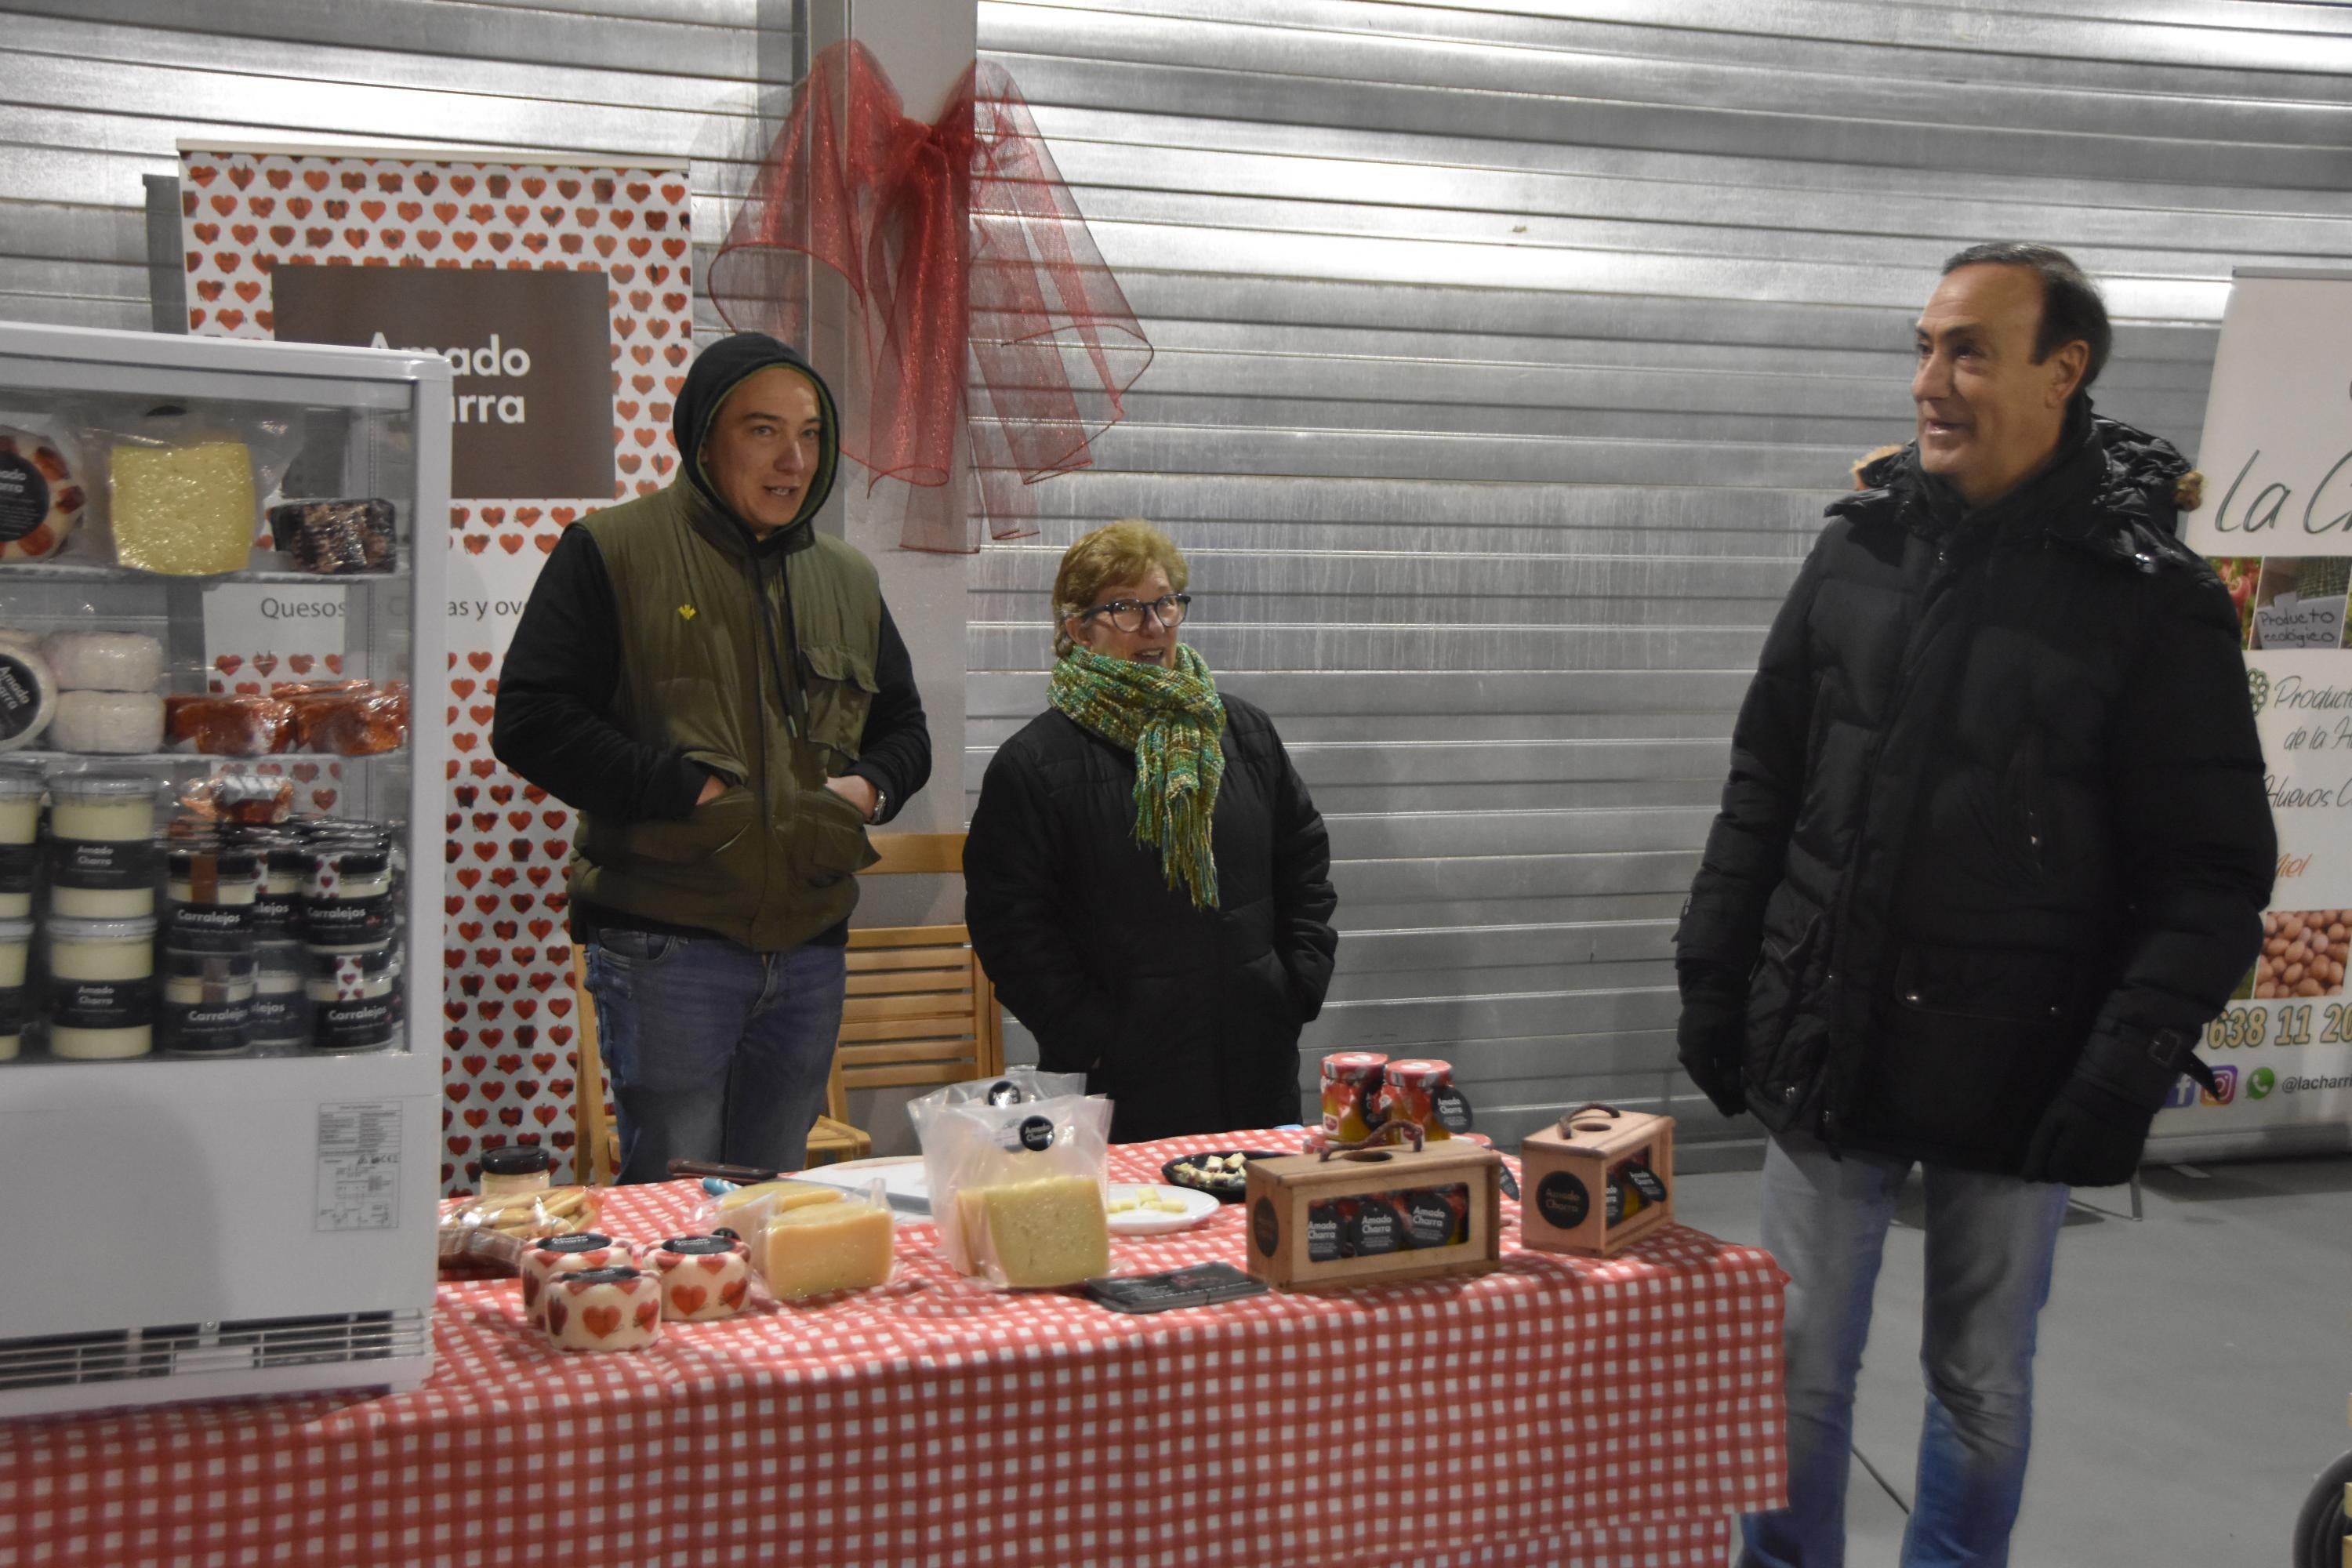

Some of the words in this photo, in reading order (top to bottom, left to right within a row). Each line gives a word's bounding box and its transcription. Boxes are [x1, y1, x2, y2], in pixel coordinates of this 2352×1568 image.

[476, 601, 488, 621] y
[495, 601, 529, 616] ov
[2258, 608, 2335, 626] Producto
[2284, 726, 2307, 750] de
[2309, 726, 2328, 750] la
[2263, 774, 2333, 808] Huevos
[77, 845, 114, 855] Amado
[176, 909, 241, 927] Carralejos
[307, 906, 367, 920] Carralejos
[328, 1004, 388, 1021] Carralejos
[2207, 1006, 2268, 1049] 638
[2274, 1004, 2312, 1046] 11
[1413, 1205, 1446, 1218] Amado
[1308, 1221, 1337, 1230] Amado
[1361, 1214, 1392, 1225] Amado
[1413, 1215, 1443, 1227] Charra
[1308, 1230, 1336, 1240] Charra
[1362, 1224, 1392, 1234] Charra
